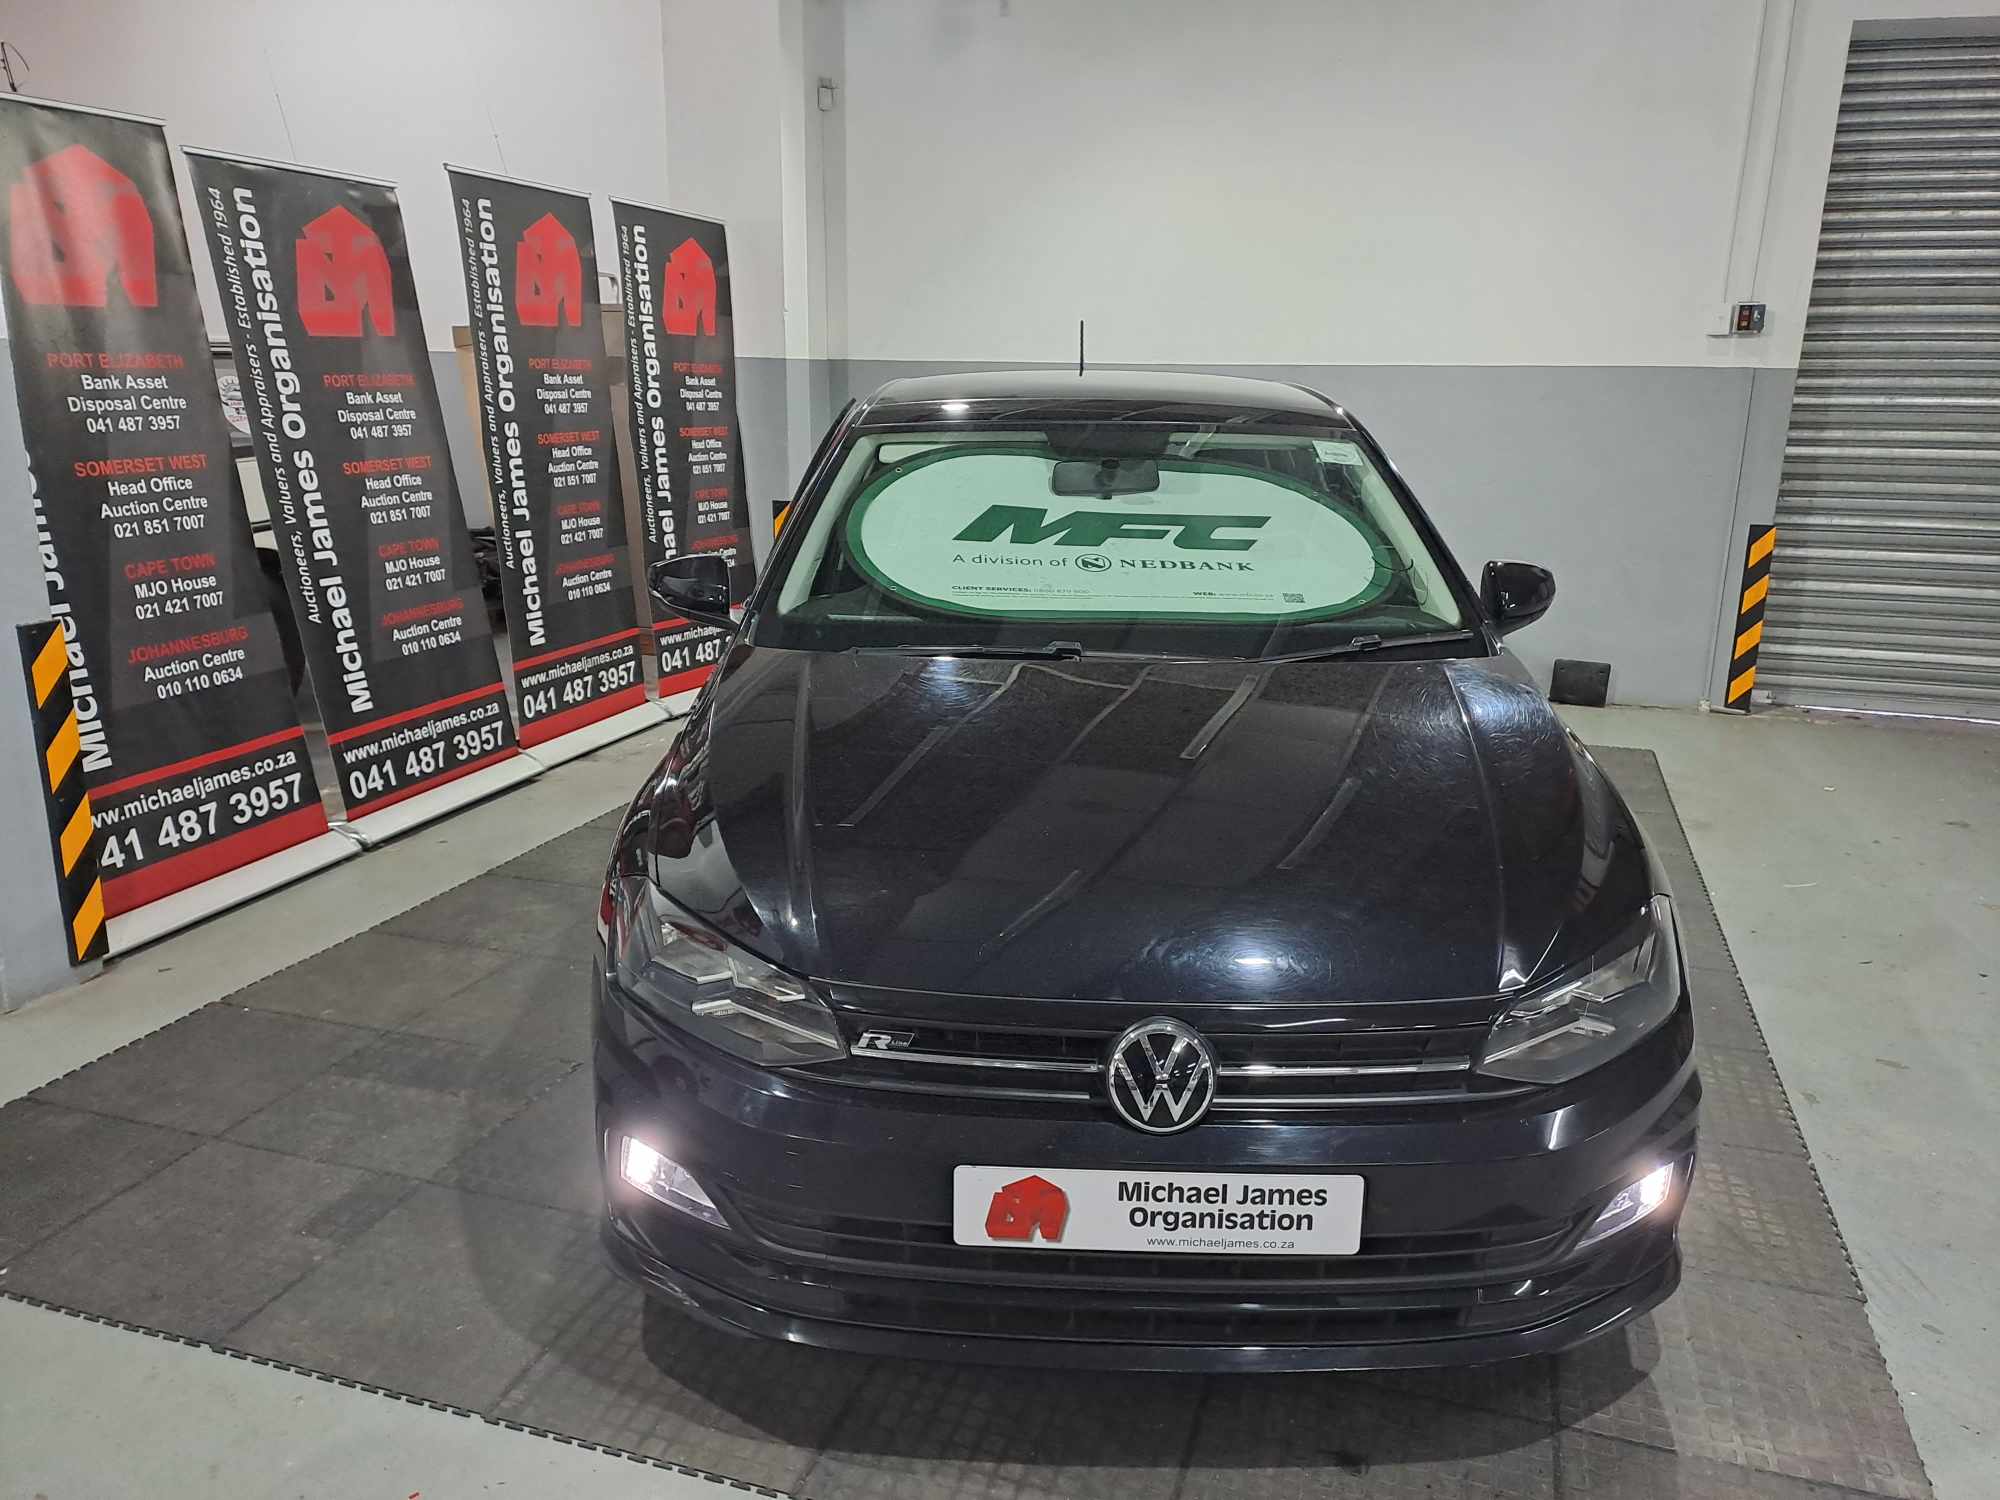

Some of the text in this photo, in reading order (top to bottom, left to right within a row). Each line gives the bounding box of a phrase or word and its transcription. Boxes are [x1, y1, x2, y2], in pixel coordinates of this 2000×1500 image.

[623, 258, 636, 327] Established
[47, 353, 93, 368] PORT
[629, 337, 643, 402] Appraisers
[633, 224, 671, 502] James Organisation
[81, 374, 168, 390] Bank Asset
[461, 198, 515, 569] Auctioneers, Valuers and Appraisers Established 1964
[543, 373, 583, 385] Bank Asset
[67, 395, 187, 414] Disposal Centre
[208, 187, 322, 624] Auctioneers, Valuers and Appraisers Established 1964
[346, 391, 403, 405] Bank Asset
[537, 388, 592, 401] Disposal Centre
[337, 408, 416, 424] Disposal Centre
[544, 402, 588, 414] 041 487 3957
[634, 402, 645, 425] and
[86, 415, 180, 433] 041 487 3957
[350, 424, 412, 440] 041 487 3957
[477, 198, 547, 647] Michael James Organisation
[232, 187, 374, 713] Michael James Organisation
[552, 446, 592, 459] Head Office
[638, 428, 650, 470] Valuers
[74, 454, 208, 477] SOMERSET WEST
[342, 459, 402, 475] SOMERSET
[548, 460, 599, 474] Auction Centre
[107, 476, 193, 496] Head Office
[365, 474, 422, 491] Head Office
[553, 477, 566, 488] 021
[101, 496, 208, 519] Auction Centre
[361, 490, 433, 508] Auction Centre
[643, 473, 657, 543] Auctioneers,
[114, 514, 205, 538] 021 851 7007
[370, 505, 431, 525] 021 851 7007
[561, 516, 601, 530] MJO House
[560, 528, 604, 544] 021 421 7007
[952, 504, 1272, 551] MFC
[124, 553, 216, 579] CAPE TOWN
[384, 555, 440, 574] MJO House
[952, 553, 1255, 571] A division of NEDBANK
[134, 575, 217, 599] MJO House
[386, 569, 446, 591] 021 421 7007
[562, 569, 613, 588] Auction Centre
[568, 589, 581, 601] 010
[582, 585, 593, 597] 110
[135, 591, 224, 620] 021 421 7007
[393, 616, 463, 641] Auction Centre
[401, 631, 462, 656] 010 110 0634
[144, 647, 246, 682] Auction Centre
[521, 645, 634, 689] www.michaeljames.co.za
[662, 646, 690, 673] 041
[695, 639, 720, 663] 487
[156, 666, 243, 699] 010 110 0634
[523, 660, 636, 719] 041 487 3957
[343, 702, 500, 764] www.michaeljames.co.za
[350, 720, 503, 800] 041 487 3957
[101, 772, 302, 869] 41 487 3957
[1118, 1181, 1328, 1206] Michael James
[1129, 1206, 1314, 1232] Organisation
[1147, 1237, 1295, 1250] www.michaeljames.co.za
